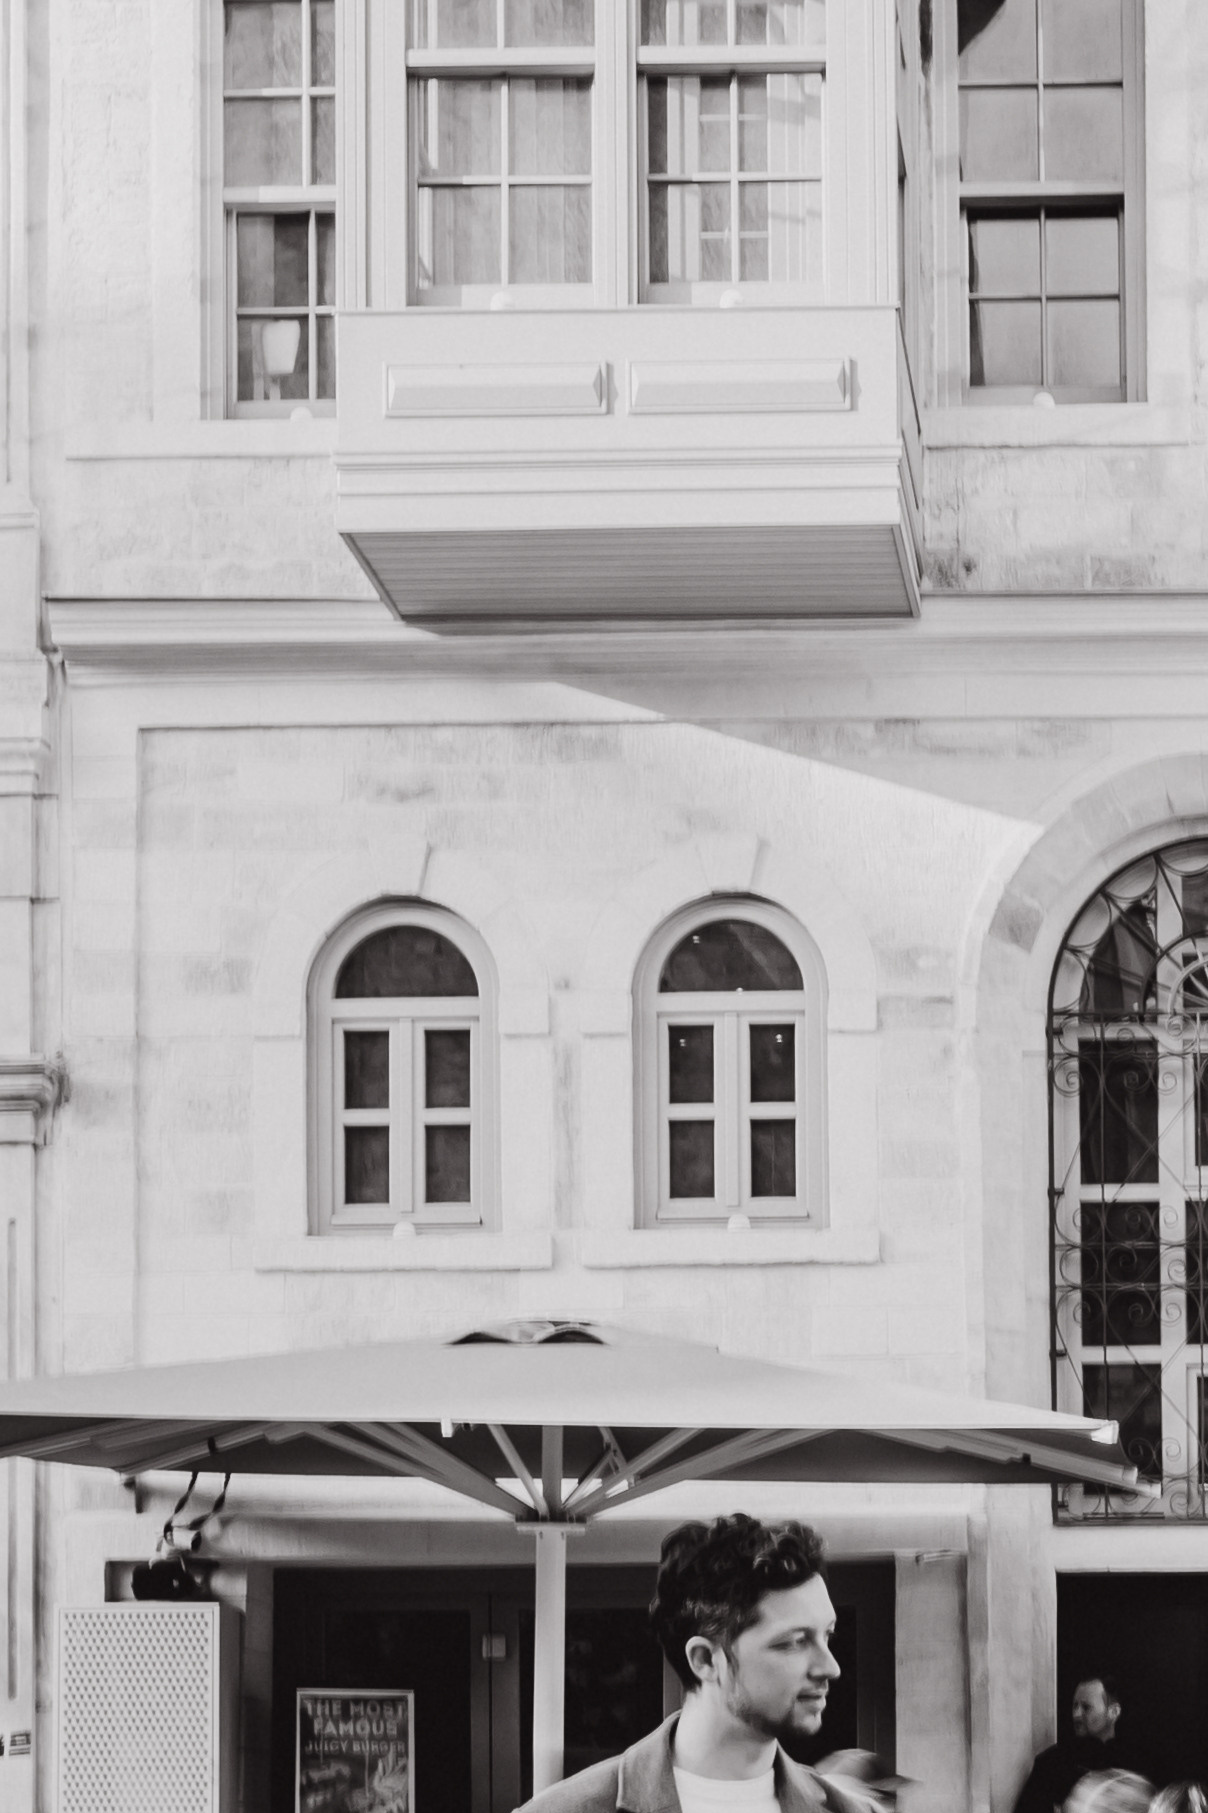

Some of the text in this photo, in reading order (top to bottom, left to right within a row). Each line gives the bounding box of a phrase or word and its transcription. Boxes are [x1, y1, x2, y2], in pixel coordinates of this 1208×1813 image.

[304, 1700, 407, 1719] THE MOST
[314, 1718, 398, 1736] FAMOUS
[305, 1741, 405, 1754] JUICY BURGER
